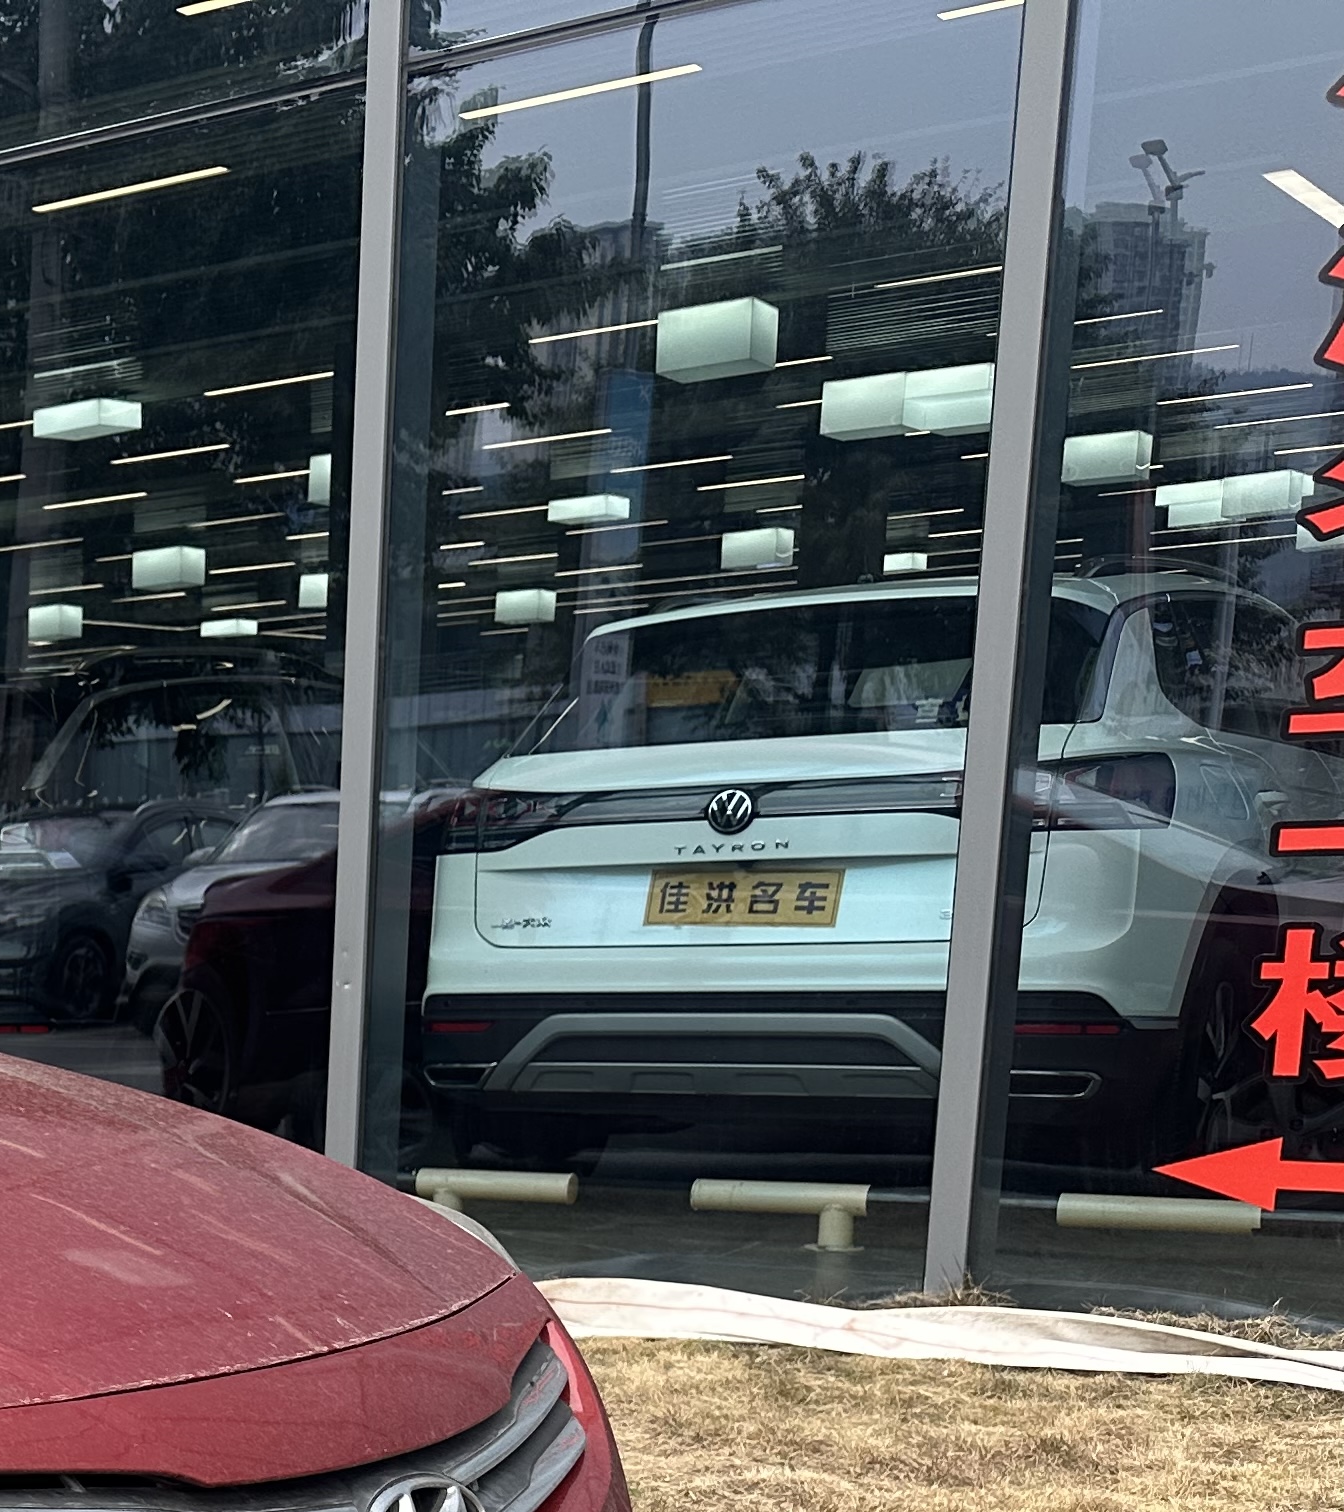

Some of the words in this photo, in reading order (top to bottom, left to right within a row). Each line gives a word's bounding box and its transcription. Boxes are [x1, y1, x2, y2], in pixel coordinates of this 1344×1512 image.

[675, 839, 790, 855] TAYRON
[659, 880, 830, 915] 佳洪名车
